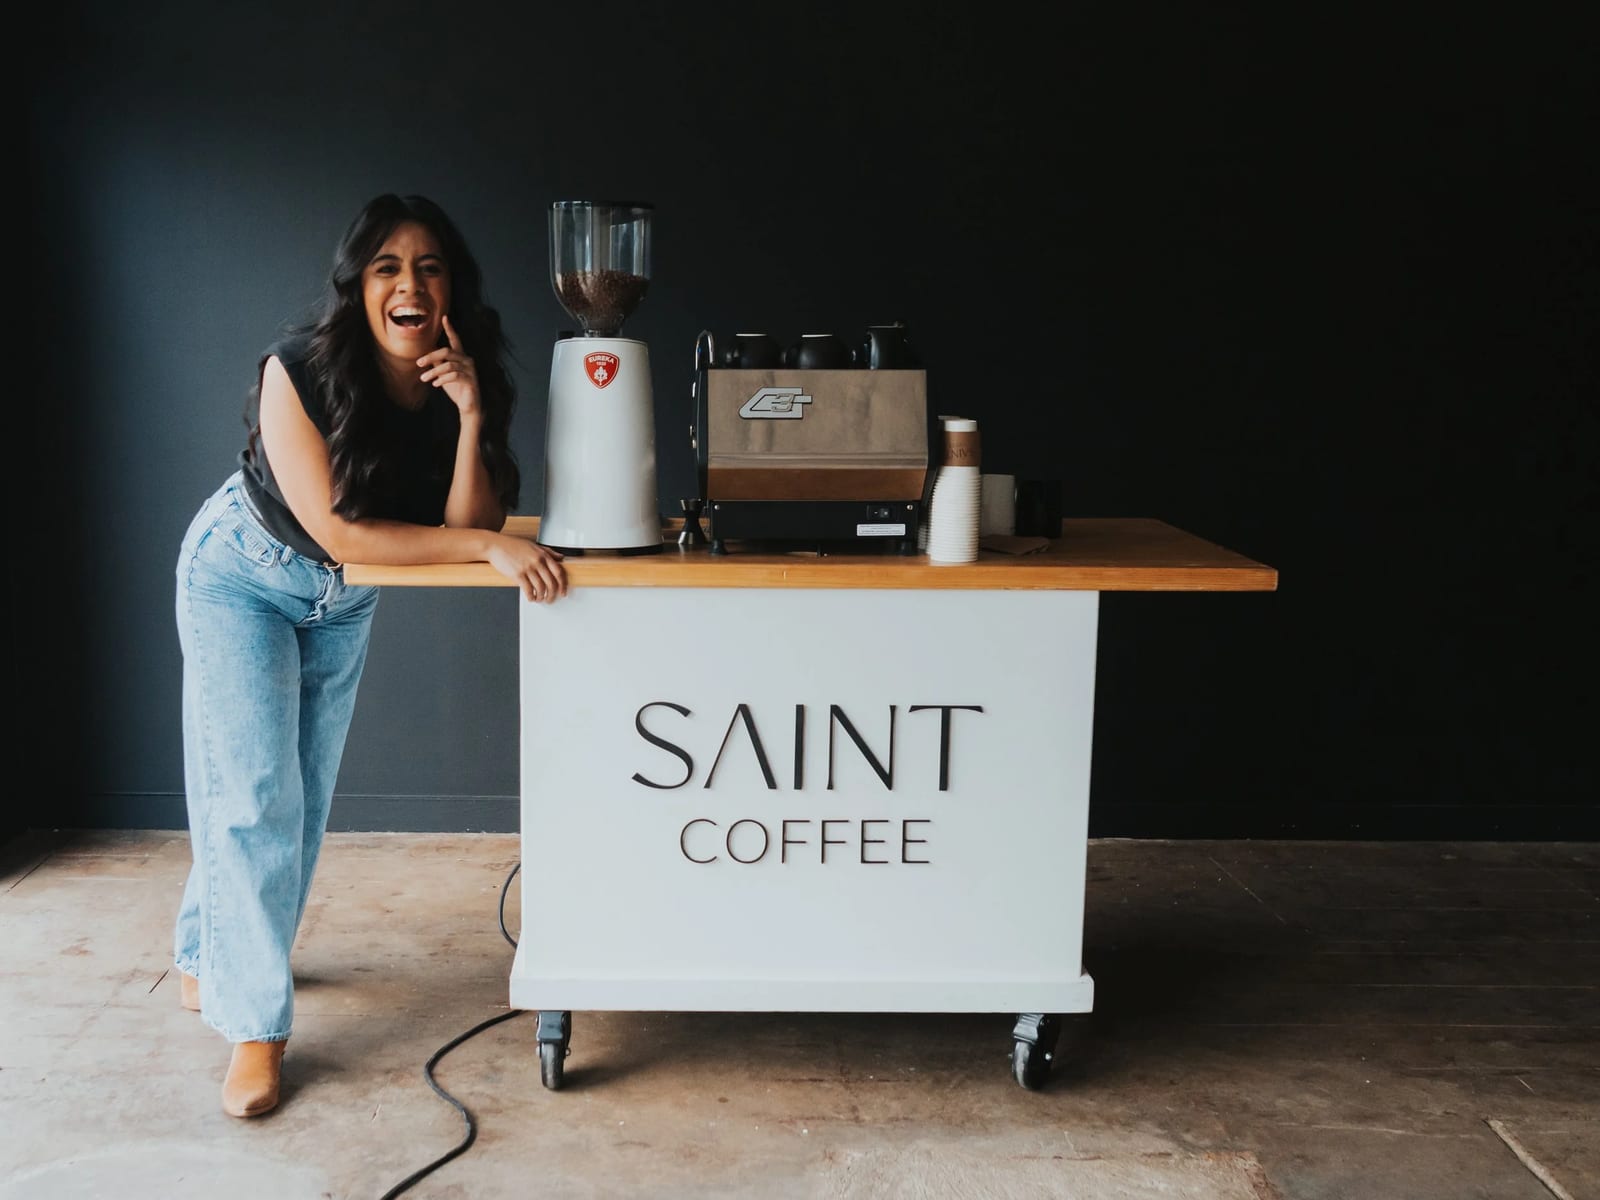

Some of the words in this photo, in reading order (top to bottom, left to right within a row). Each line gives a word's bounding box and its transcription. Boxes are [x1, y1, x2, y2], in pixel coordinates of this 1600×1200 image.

[588, 355, 614, 364] EUREKA
[632, 702, 984, 791] SAINT
[680, 819, 931, 864] COFFEE
